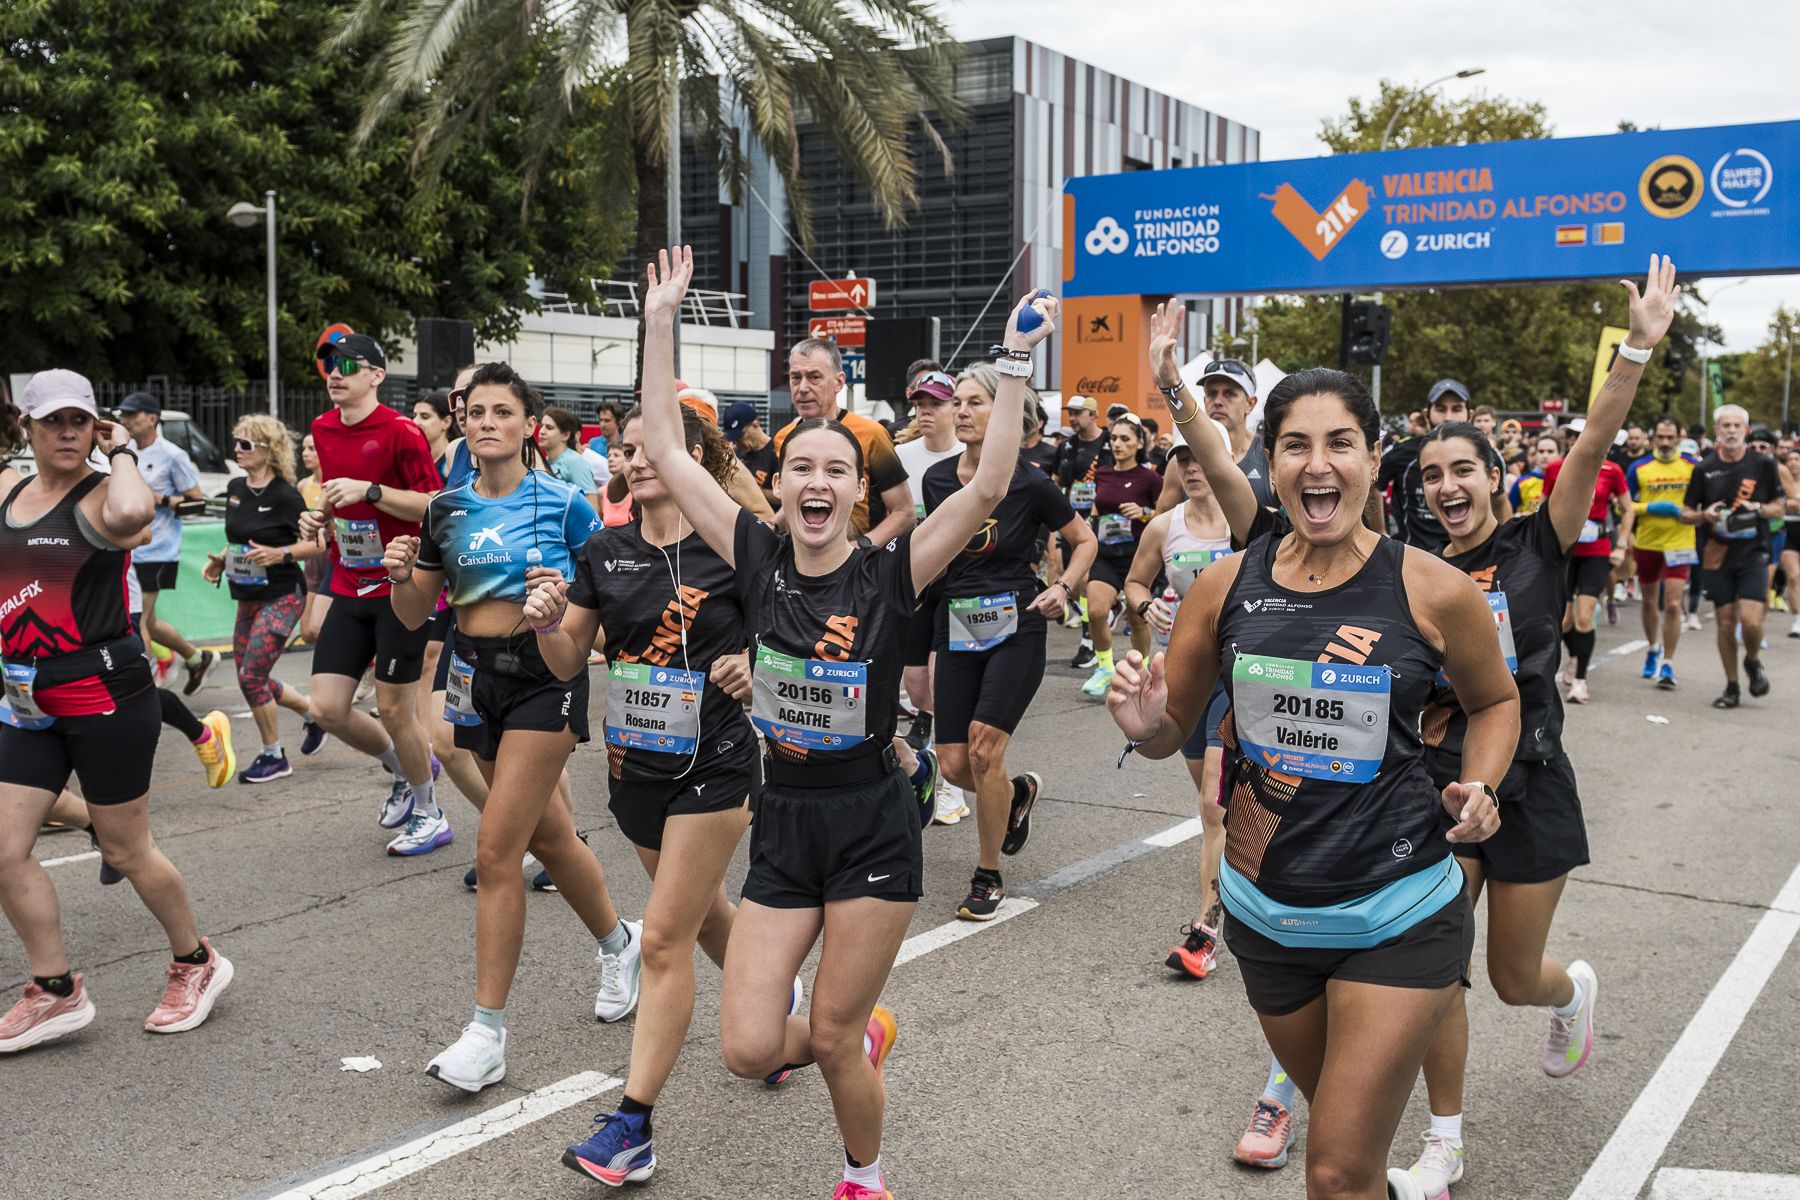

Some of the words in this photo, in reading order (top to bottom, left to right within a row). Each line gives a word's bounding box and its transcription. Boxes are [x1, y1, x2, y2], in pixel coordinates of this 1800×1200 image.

[1382, 167, 1494, 198] VALENCIA
[1722, 177, 1761, 189] HALFS
[1723, 167, 1762, 179] SUPER
[1135, 204, 1220, 220] FUNDACIÓN
[1382, 199, 1496, 225] TRINIDAD
[1501, 191, 1627, 219] ALFONSO
[1134, 219, 1220, 239] TRINIDAD
[1315, 195, 1359, 247] 21K
[1134, 236, 1220, 257] ALFONSO
[1415, 231, 1491, 252] ZURICH
[27, 537, 70, 546] METALFIX
[457, 552, 513, 567] CaixaBank
[967, 611, 998, 624] 19268
[669, 675, 697, 685] ZURICH
[826, 669, 858, 678] ZURICH
[1266, 667, 1294, 675] TRINIDAD
[1341, 674, 1380, 685] ZURICH
[625, 689, 672, 709] 21857
[777, 681, 833, 704] 20156
[561, 691, 572, 716] FILA
[1273, 693, 1344, 721] 20185
[625, 713, 666, 731] Rosana
[778, 707, 831, 729] AGATHE
[1276, 726, 1339, 751] Valérie
